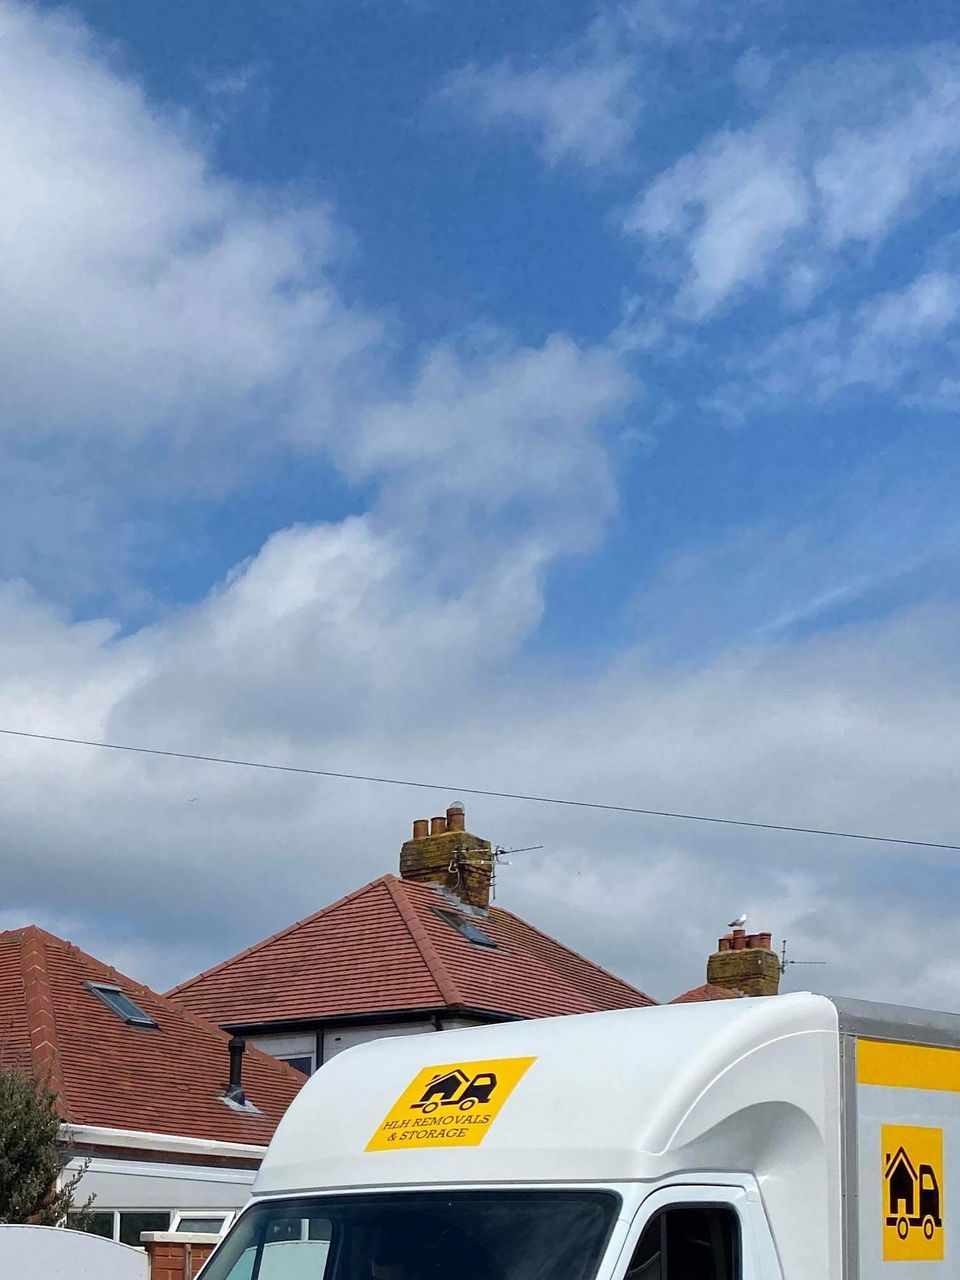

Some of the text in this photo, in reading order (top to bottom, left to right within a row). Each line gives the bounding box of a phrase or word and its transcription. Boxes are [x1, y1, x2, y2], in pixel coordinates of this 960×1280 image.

[383, 1114, 491, 1130] HLH REMOVALS
[387, 1128, 468, 1141] & STORAGE
